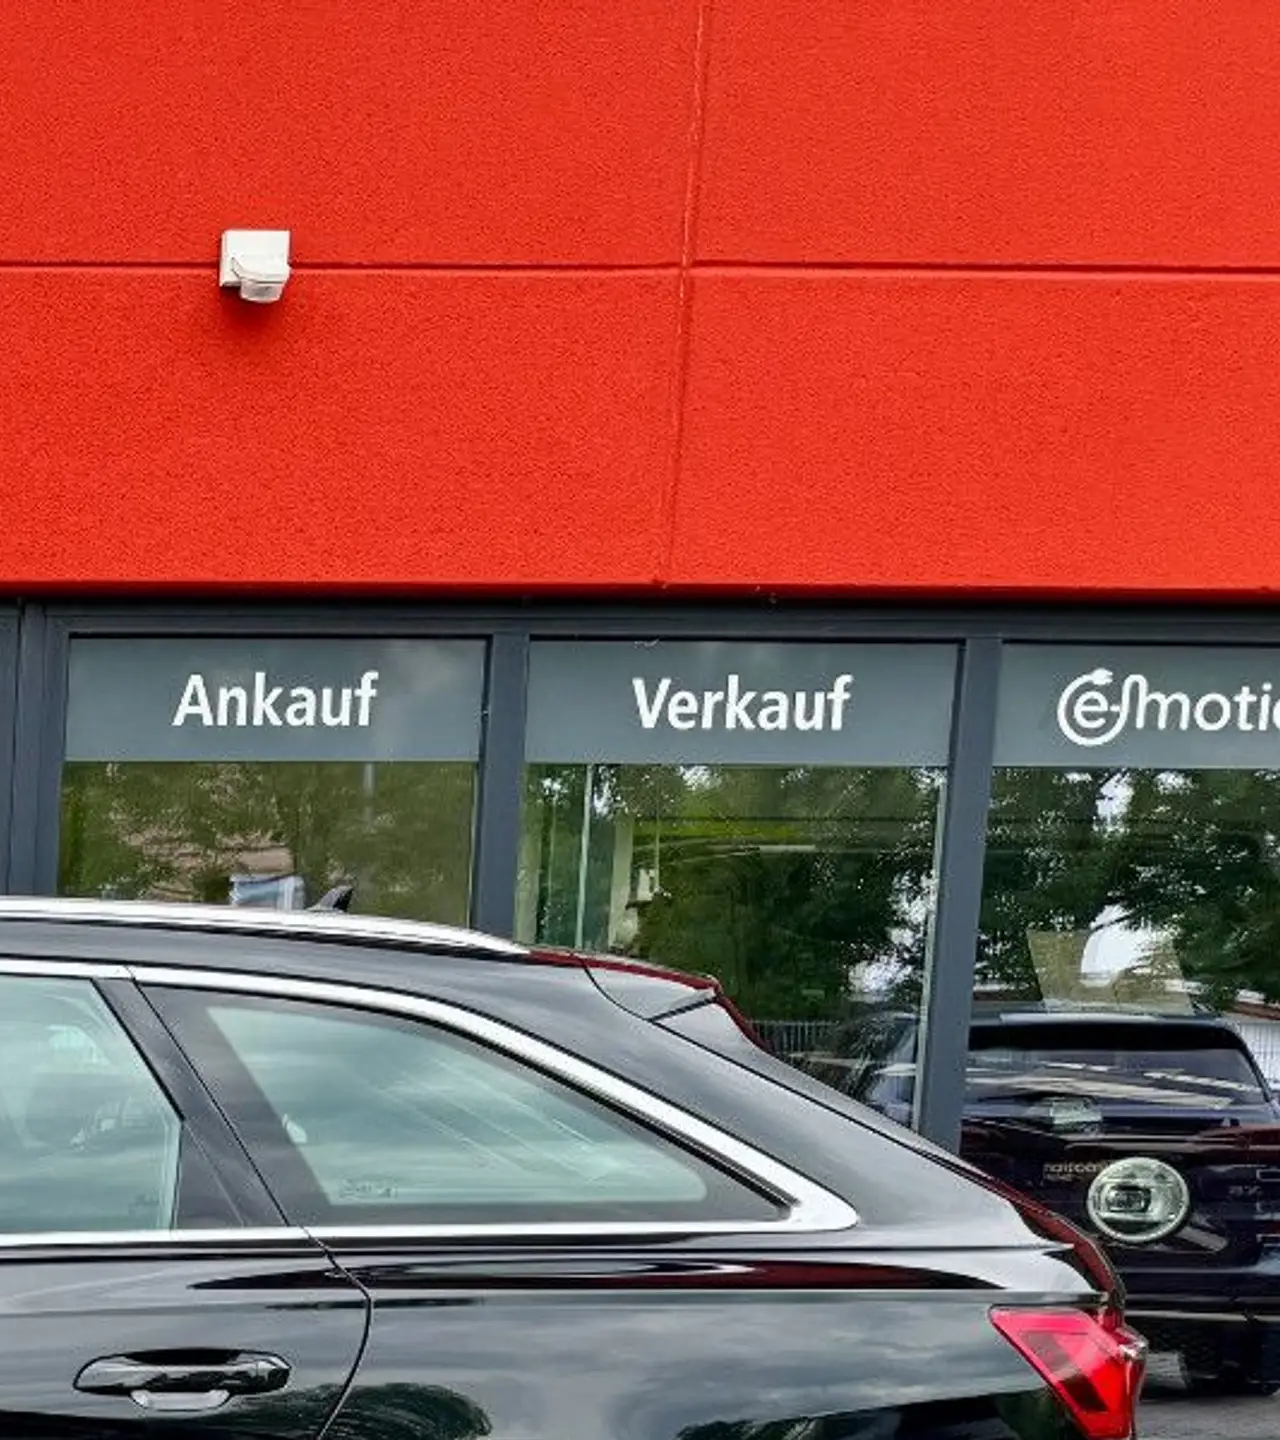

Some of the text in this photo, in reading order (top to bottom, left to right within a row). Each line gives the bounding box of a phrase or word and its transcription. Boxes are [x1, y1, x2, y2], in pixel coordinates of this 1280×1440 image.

[171, 671, 379, 727] Ankauf
[631, 673, 854, 731] Verkauf
[1056, 667, 1280, 746] e-moti
